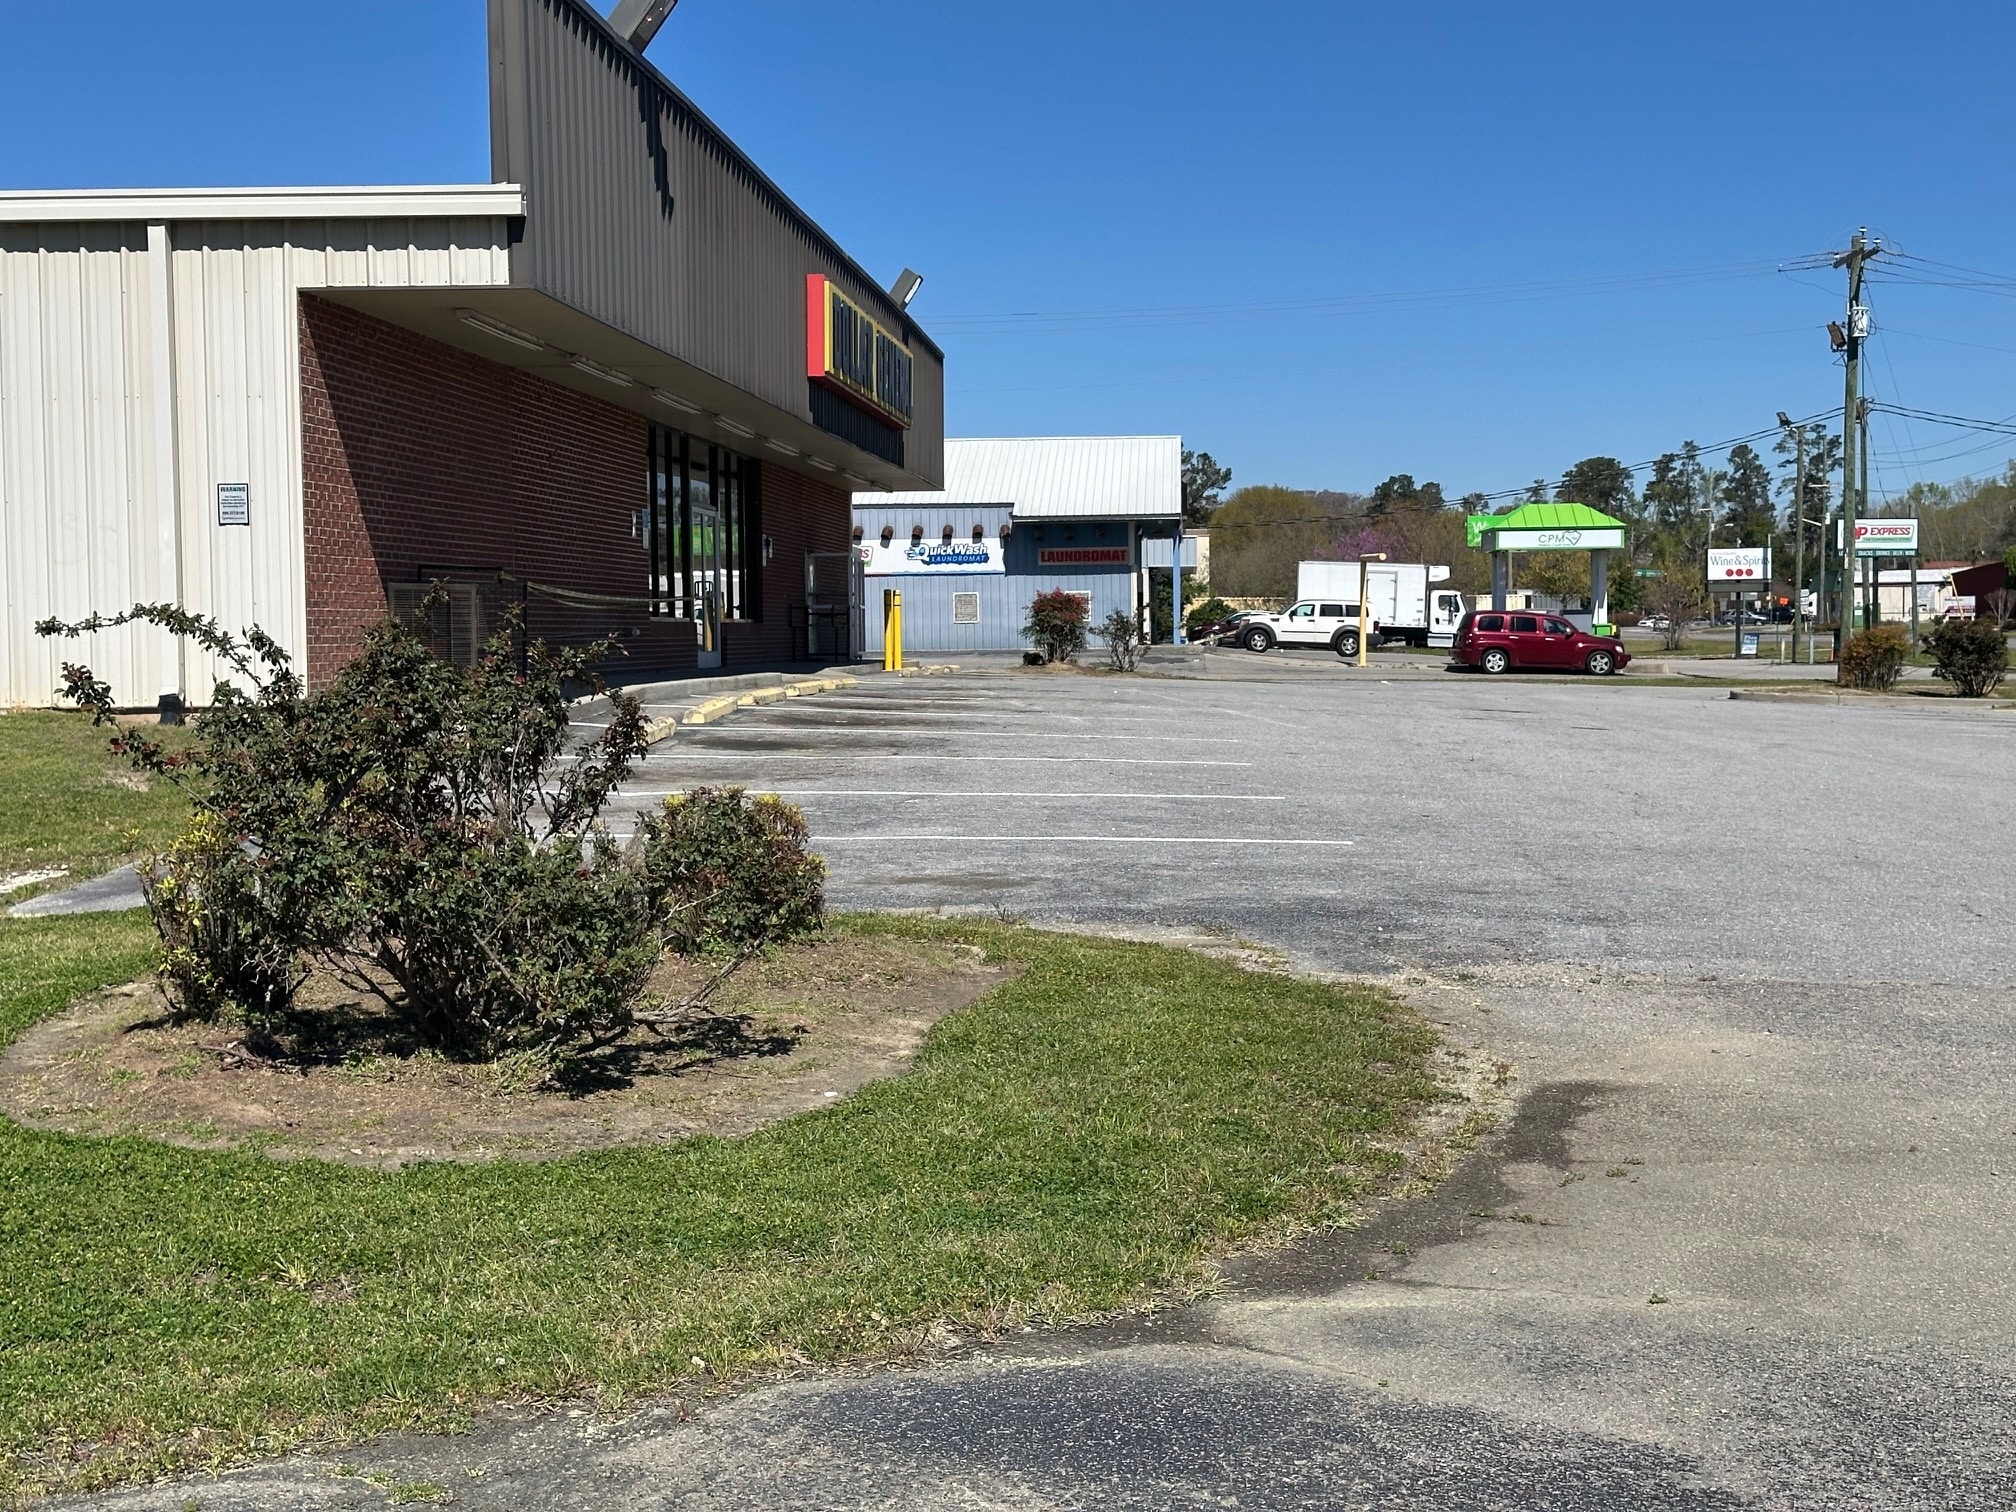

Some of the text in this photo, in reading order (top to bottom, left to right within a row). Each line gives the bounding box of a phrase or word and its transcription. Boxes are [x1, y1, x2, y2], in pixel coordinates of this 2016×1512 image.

[1870, 527, 1911, 535] EXPRESS
[1538, 534, 1565, 543] CPM
[1041, 550, 1127, 562] LAUNDROMAT
[1710, 555, 1734, 566] Wine
[1742, 554, 1770, 568] Spir
